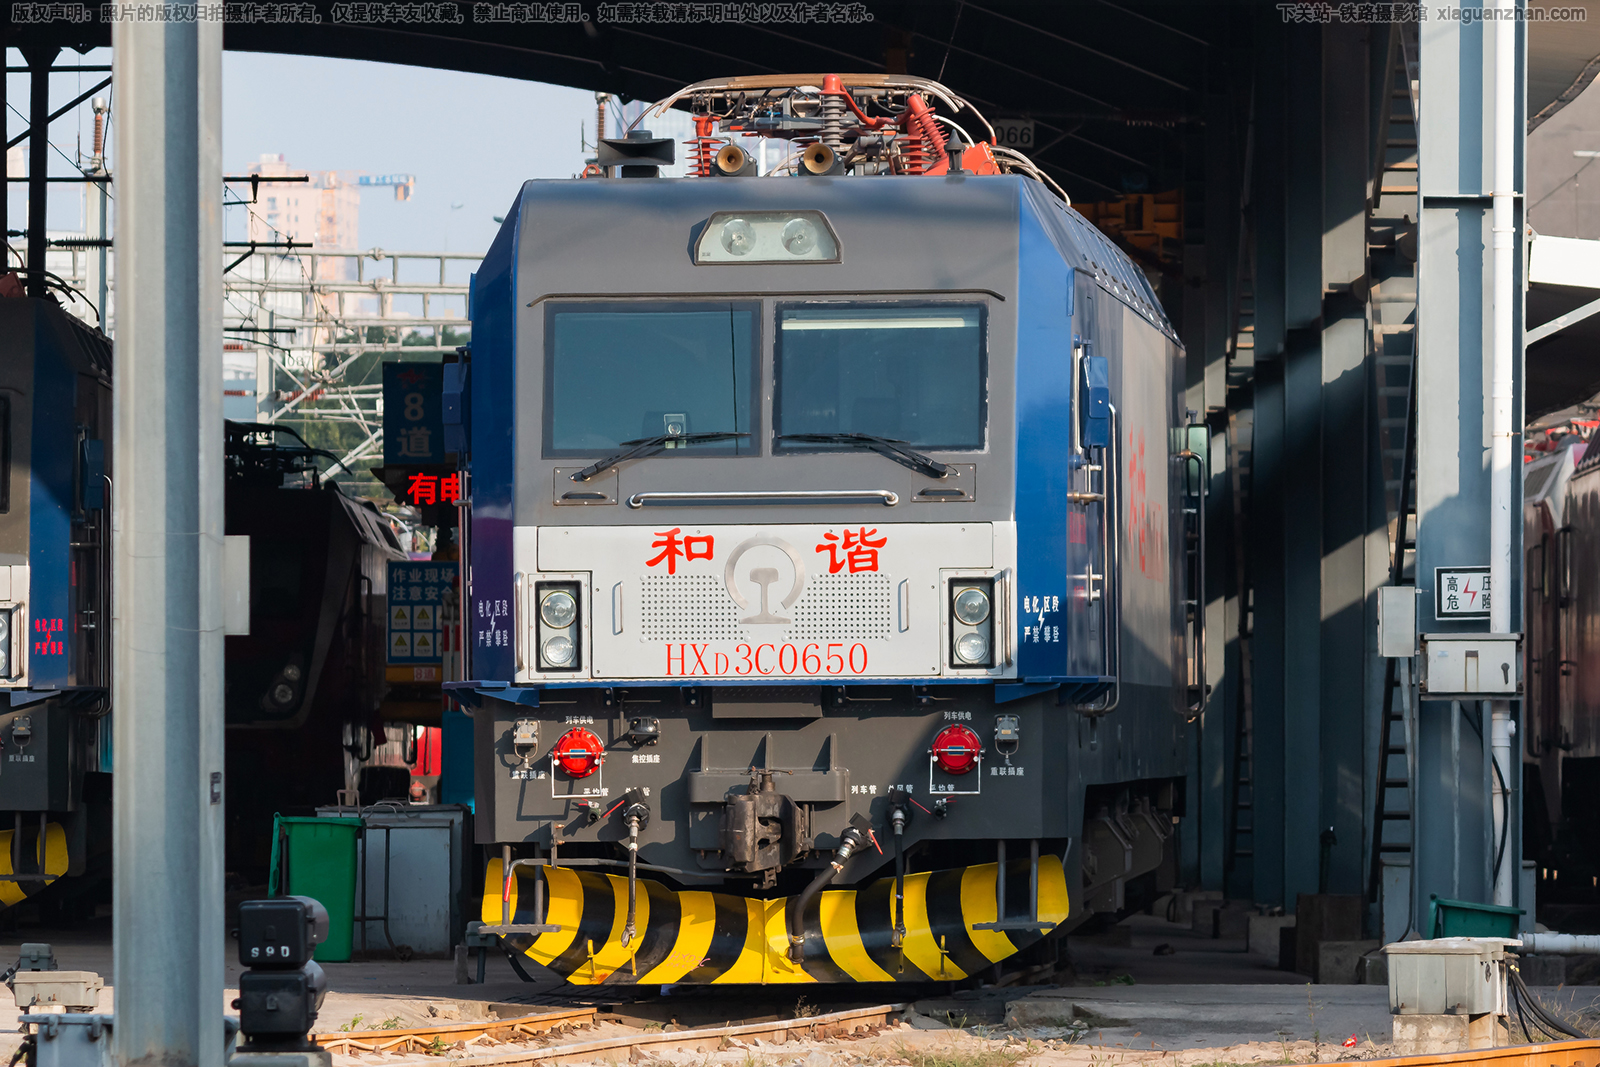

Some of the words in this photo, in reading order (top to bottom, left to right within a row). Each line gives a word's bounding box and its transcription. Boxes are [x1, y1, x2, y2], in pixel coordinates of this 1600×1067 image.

[645, 527, 715, 575] 和
[815, 527, 887, 574] 谐
[392, 568, 455, 583] 作业现场
[1023, 595, 1060, 613] 电化区段
[565, 715, 594, 725] 列车供电
[944, 711, 972, 721] 列车供电
[990, 766, 1025, 776] 重联插座
